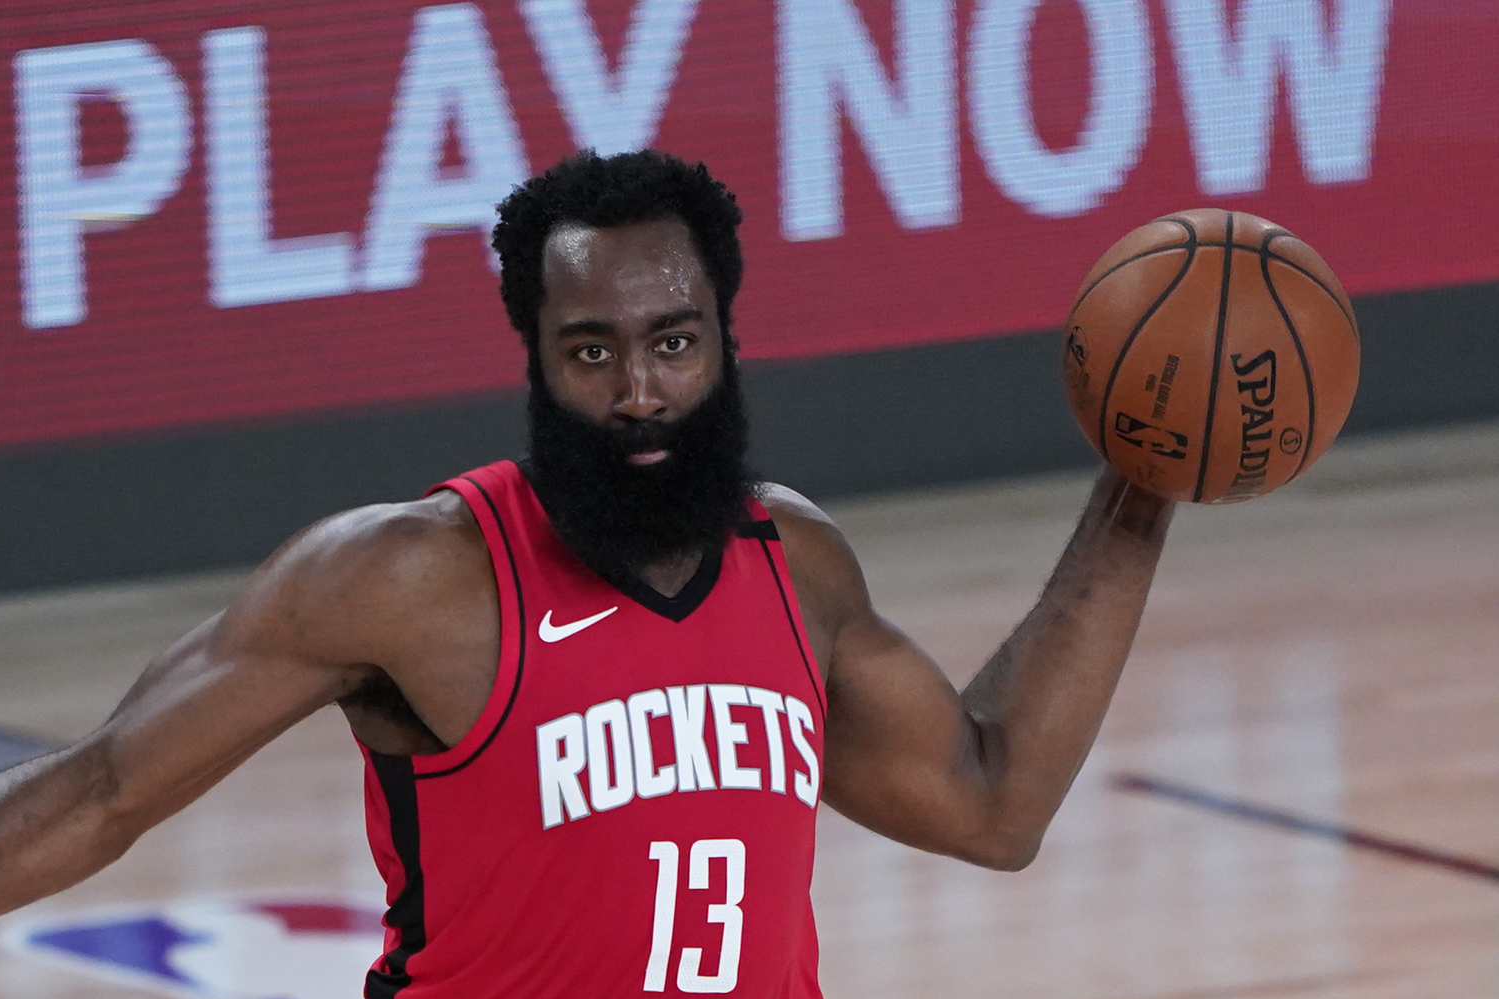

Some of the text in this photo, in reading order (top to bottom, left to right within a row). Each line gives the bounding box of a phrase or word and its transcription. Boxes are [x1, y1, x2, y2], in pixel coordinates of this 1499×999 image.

[777, 0, 1392, 242] NOW
[1230, 349, 1277, 499] SPALDI
[536, 684, 820, 831] ROCKETS
[643, 838, 747, 994] 13
